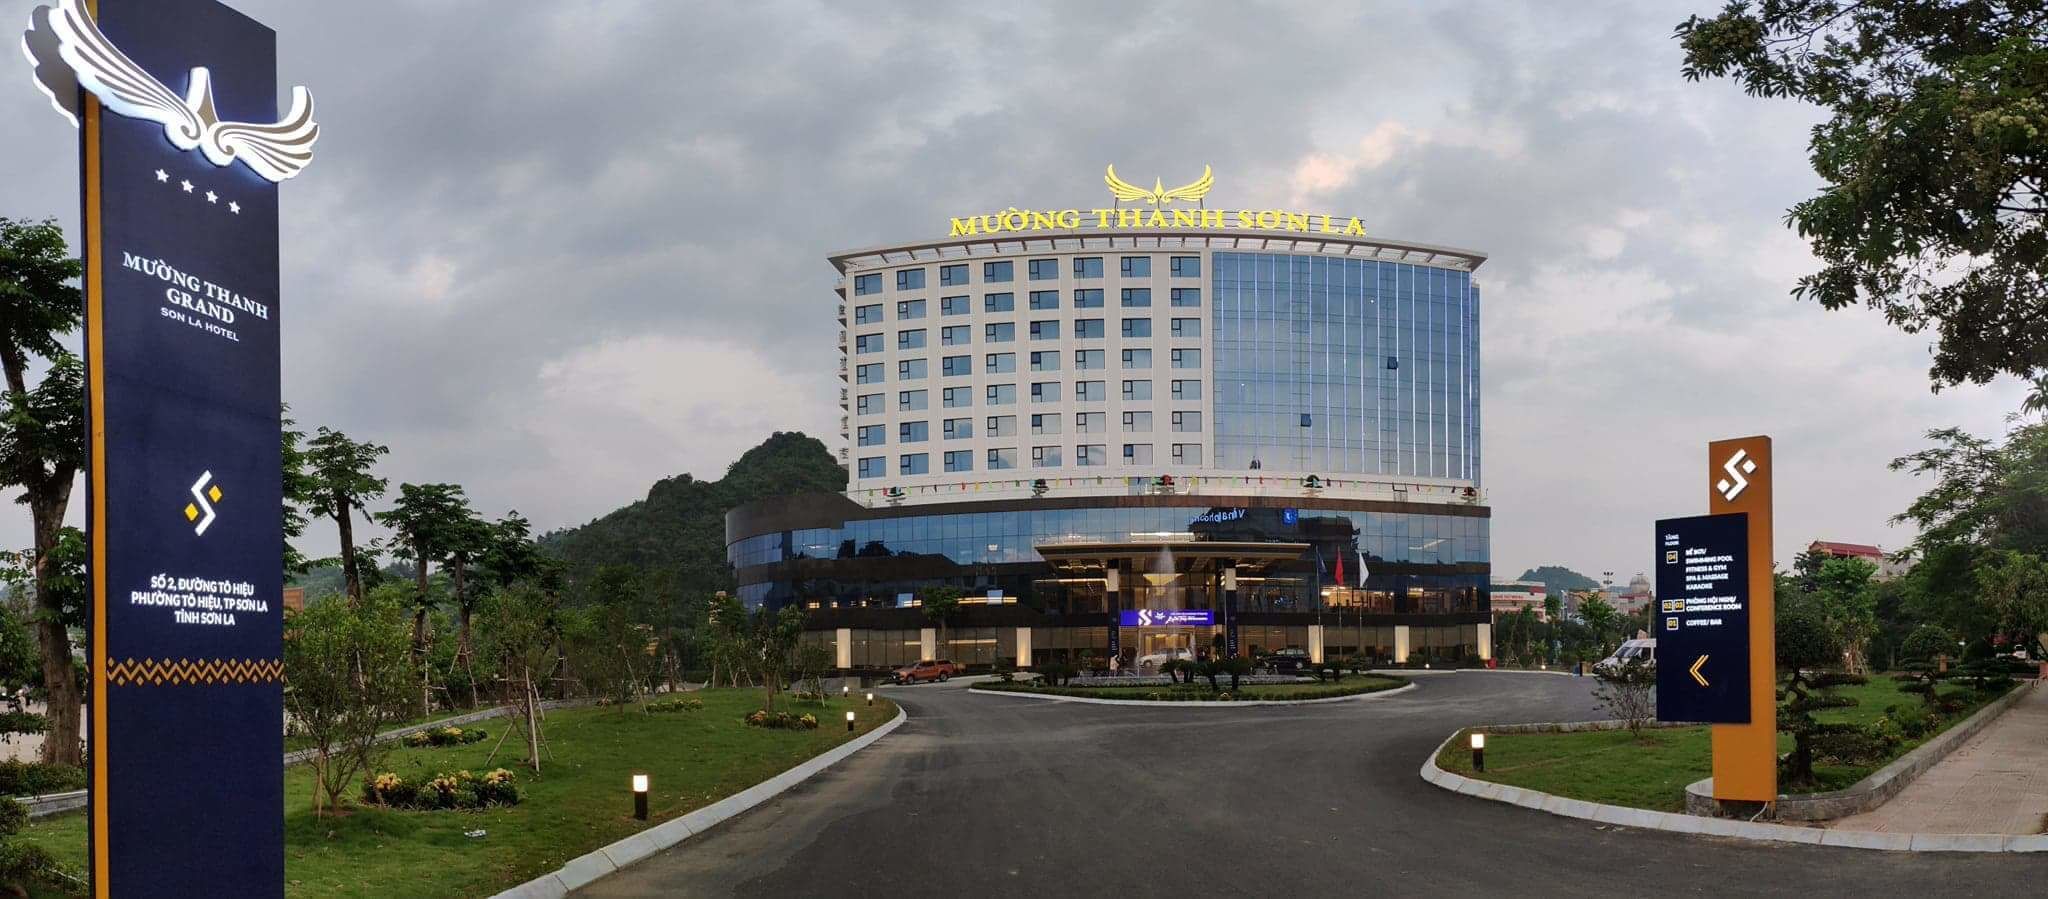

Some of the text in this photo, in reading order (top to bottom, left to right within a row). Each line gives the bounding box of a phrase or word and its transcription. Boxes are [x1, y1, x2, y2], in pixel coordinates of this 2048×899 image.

[949, 207, 1081, 237] MƯỜNG
[1091, 207, 1225, 229] THANH
[1319, 214, 1367, 237] LA
[122, 252, 269, 320] MƯỜNG THANH
[166, 288, 235, 324] GRAND
[160, 307, 240, 342] SON LA HOTEL
[1685, 565, 1707, 573] FITNESS
[151, 573, 255, 597] SỐ 2, ĐƯỜNG TÔ HIỆU
[131, 589, 181, 607] PHƯỜNG
[181, 593, 196, 607] TÔ
[223, 597, 236, 610] TP
[256, 600, 269, 612] LA
[1685, 602, 1742, 612] CONFERENCE ROOM
[200, 612, 222, 625] SƠN
[222, 614, 236, 626] LA
